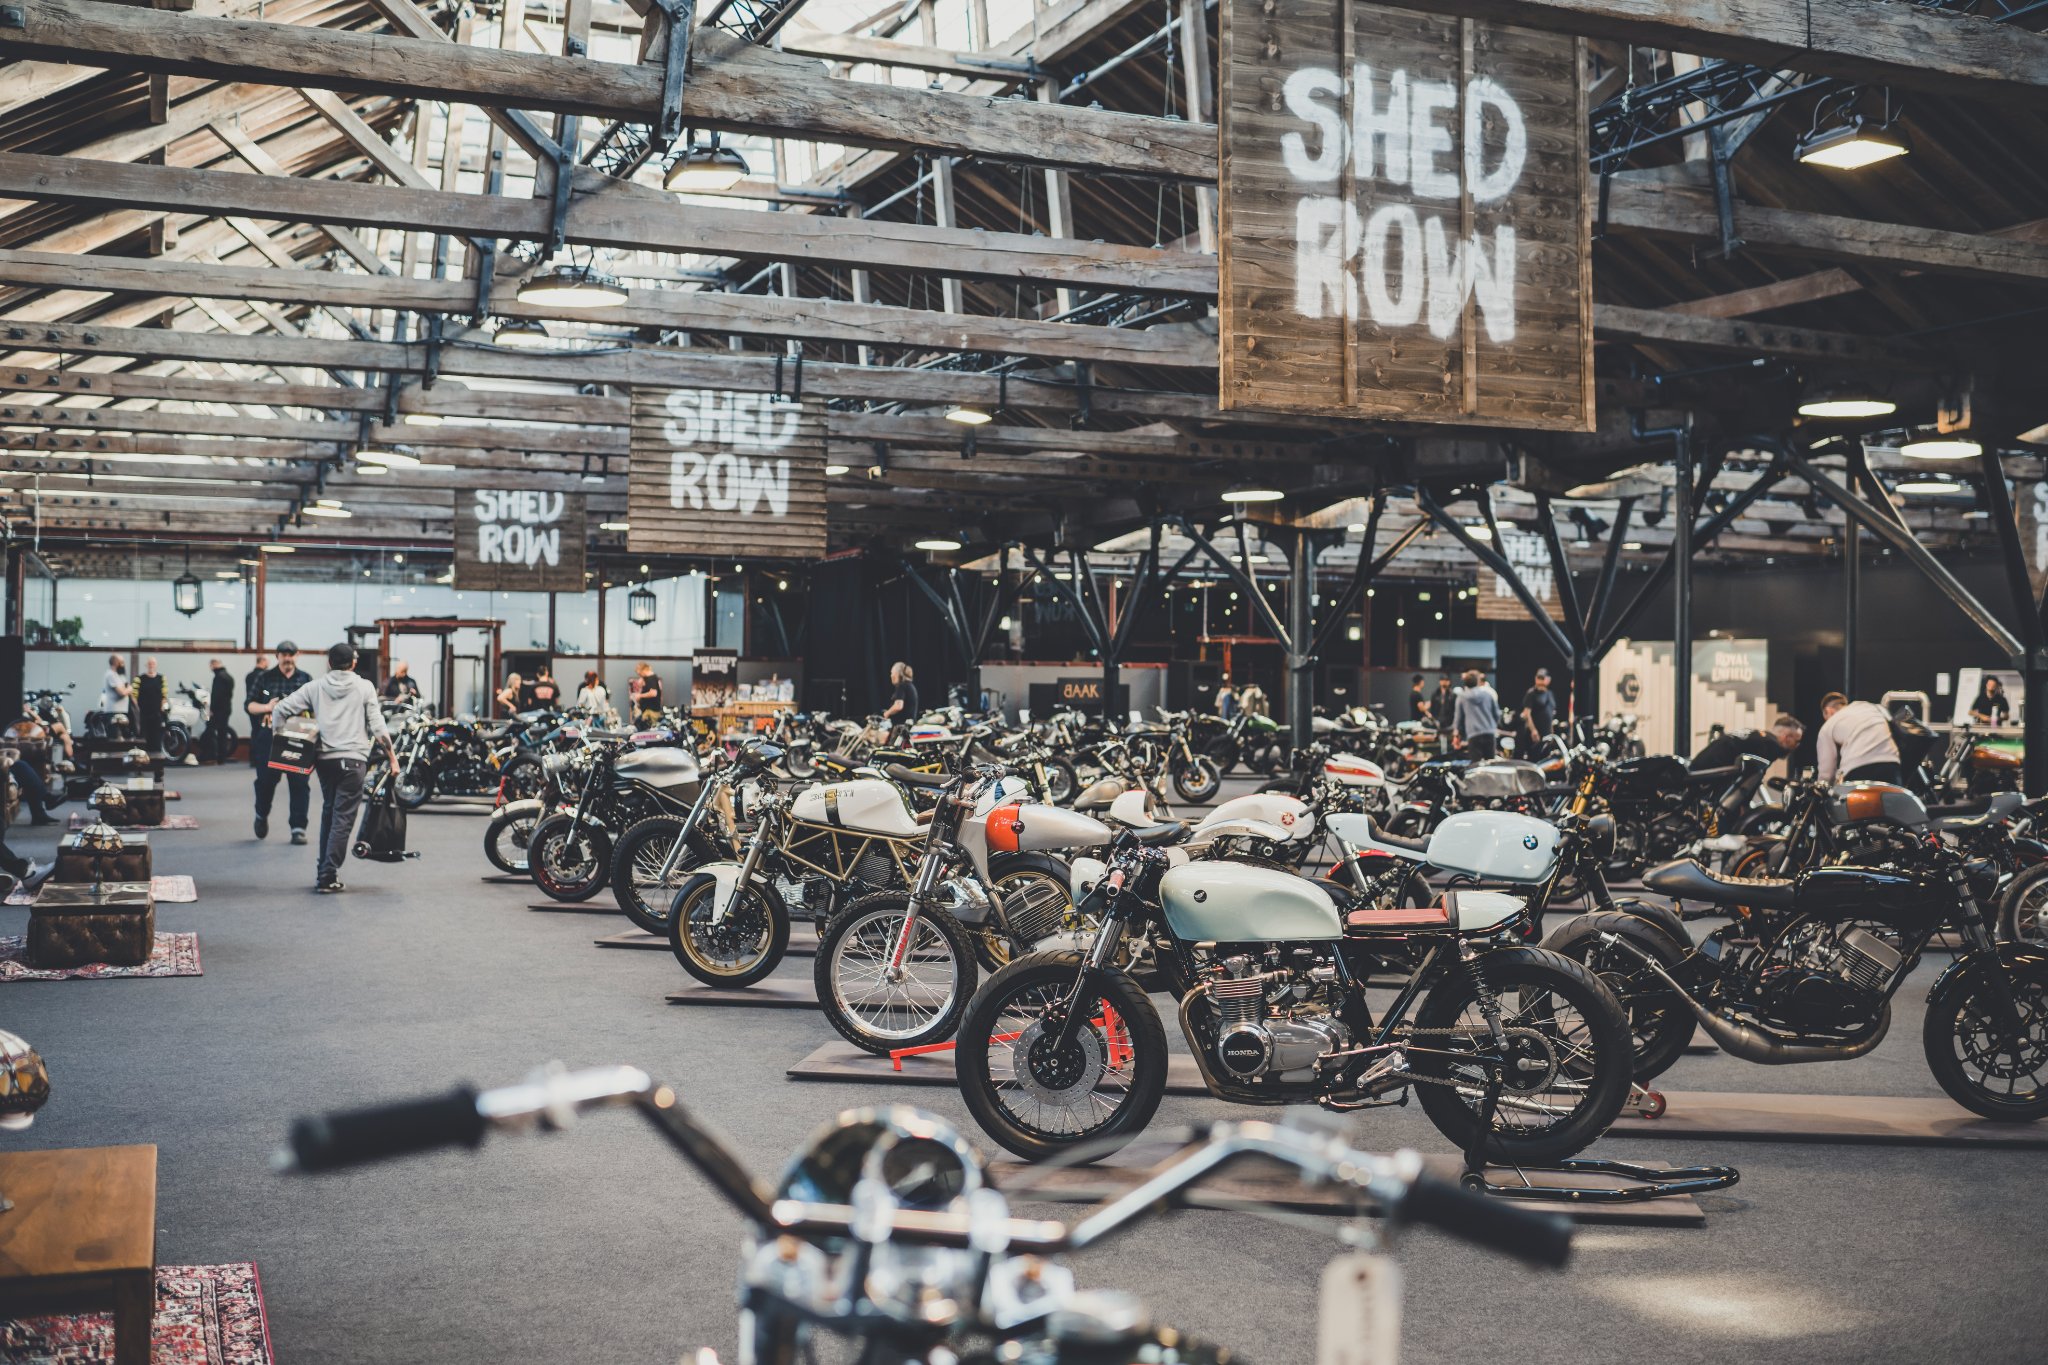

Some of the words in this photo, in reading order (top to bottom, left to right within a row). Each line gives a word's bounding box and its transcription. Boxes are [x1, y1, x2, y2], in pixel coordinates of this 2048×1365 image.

[1280, 62, 1527, 202] SHED
[1295, 196, 1516, 343] ROW
[664, 389, 798, 450] SHED
[669, 451, 790, 516] ROW
[478, 524, 560, 567] ROW
[1711, 666, 1754, 683] ENFIELD
[1715, 651, 1750, 667] ROYAL
